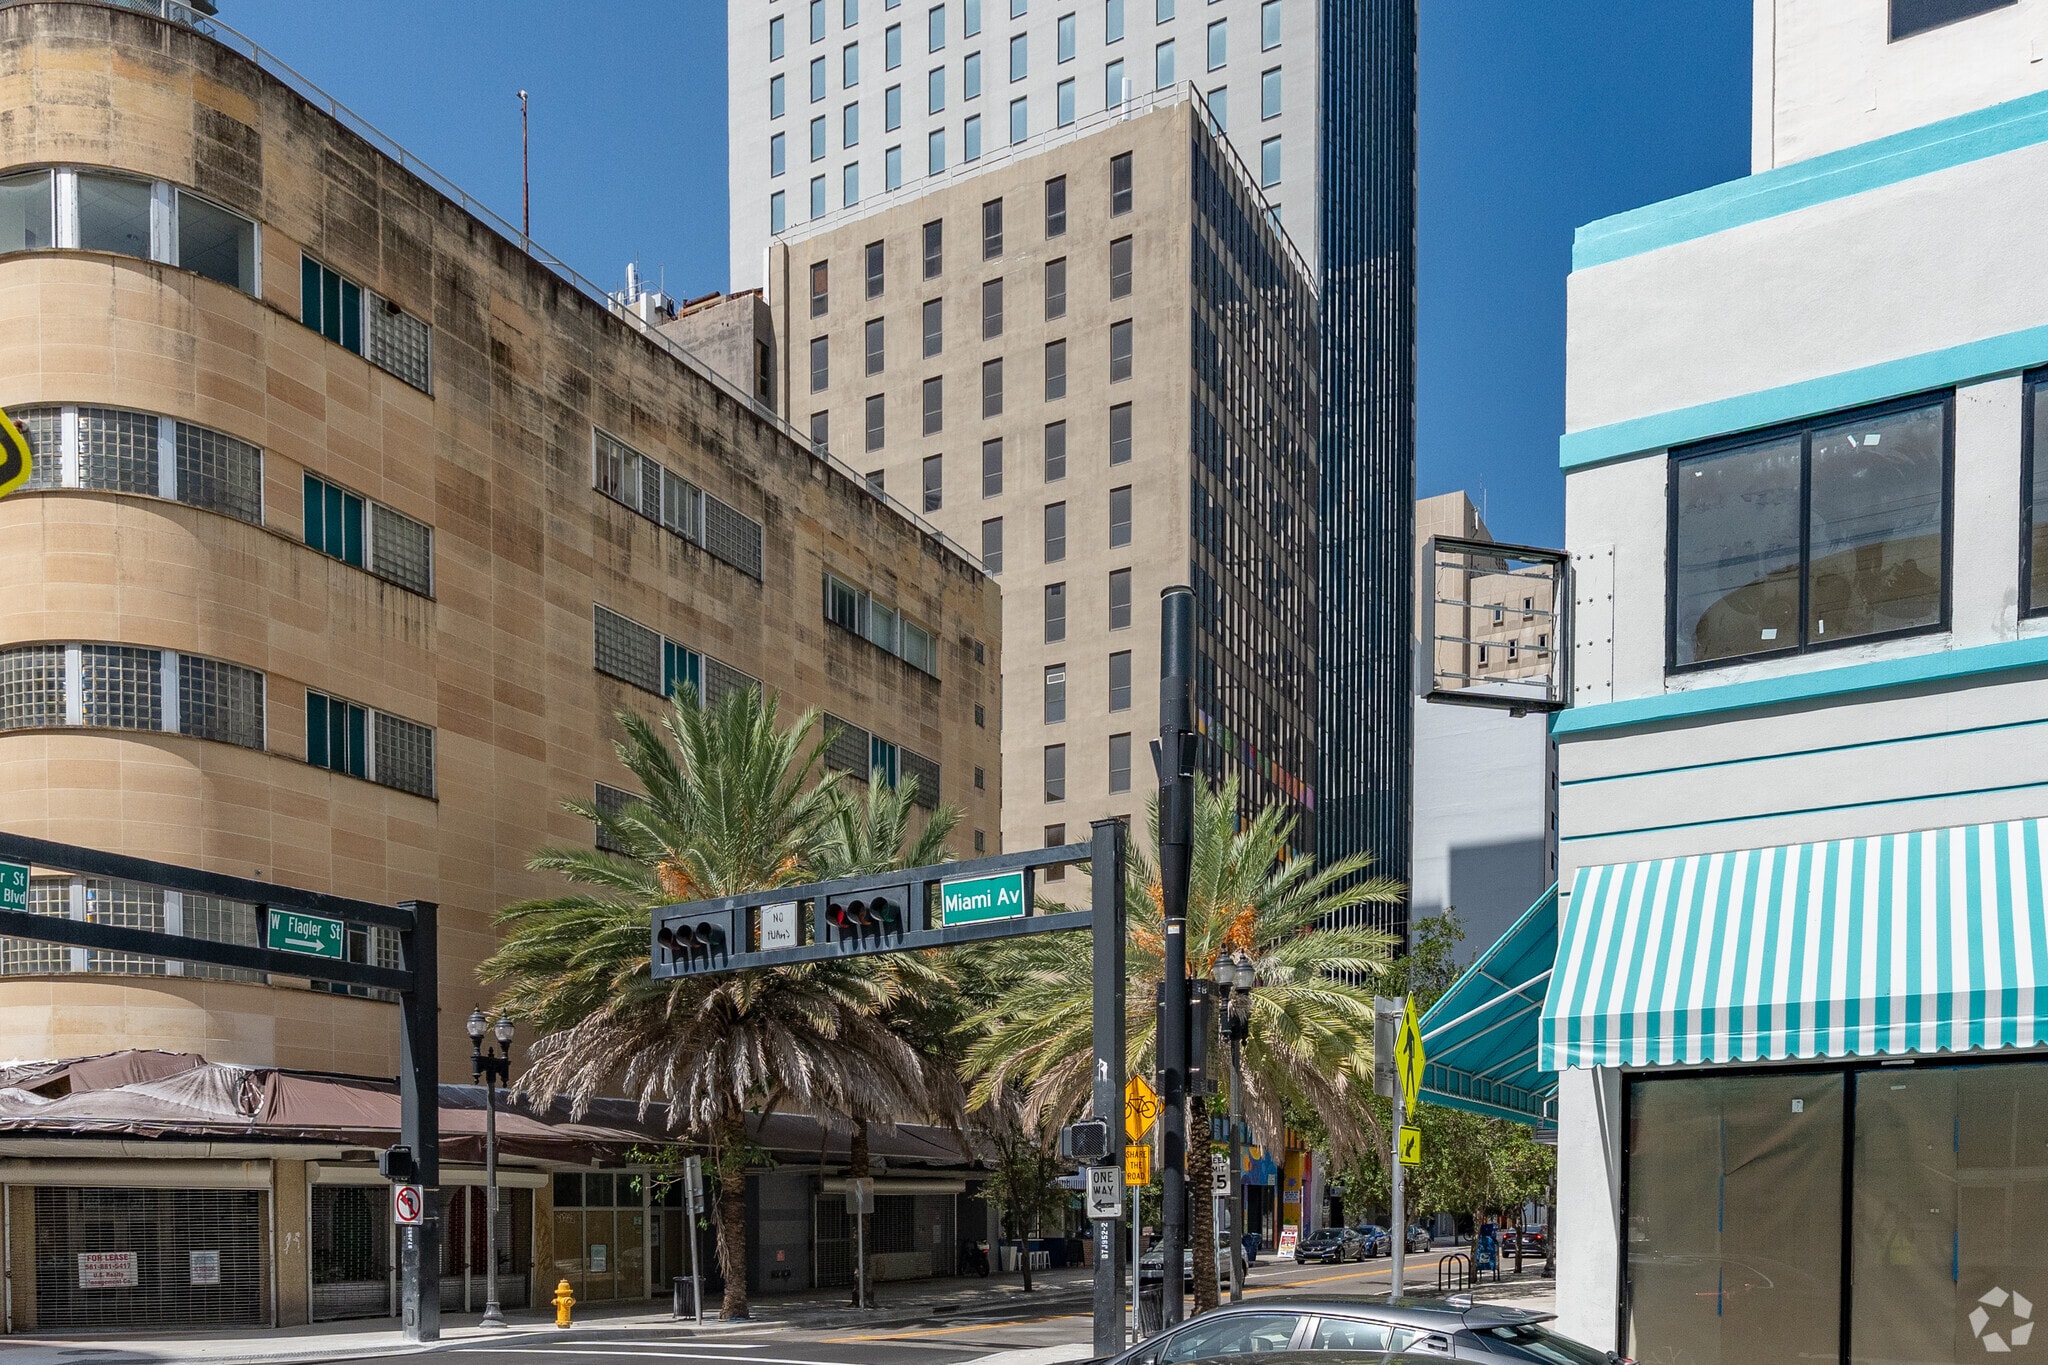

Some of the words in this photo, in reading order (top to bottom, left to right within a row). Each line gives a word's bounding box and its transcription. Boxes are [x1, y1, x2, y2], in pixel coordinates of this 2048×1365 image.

[13, 871, 25, 887] St
[3, 887, 26, 905] Blvd
[945, 889, 992, 913] Miami
[996, 887, 1020, 906] Av
[772, 912, 784, 923] NO
[271, 913, 281, 930] W
[288, 916, 322, 940] Flagler
[329, 923, 341, 940] St
[1125, 1150, 1147, 1159] SHARE
[1130, 1161, 1143, 1169] THE
[1212, 1156, 1228, 1165] EED
[1093, 1171, 1114, 1184] ONE
[1127, 1172, 1146, 1181] ROAD
[1093, 1185, 1114, 1196] WAY
[86, 1254, 103, 1262] FOR
[105, 1253, 129, 1261] LEASE
